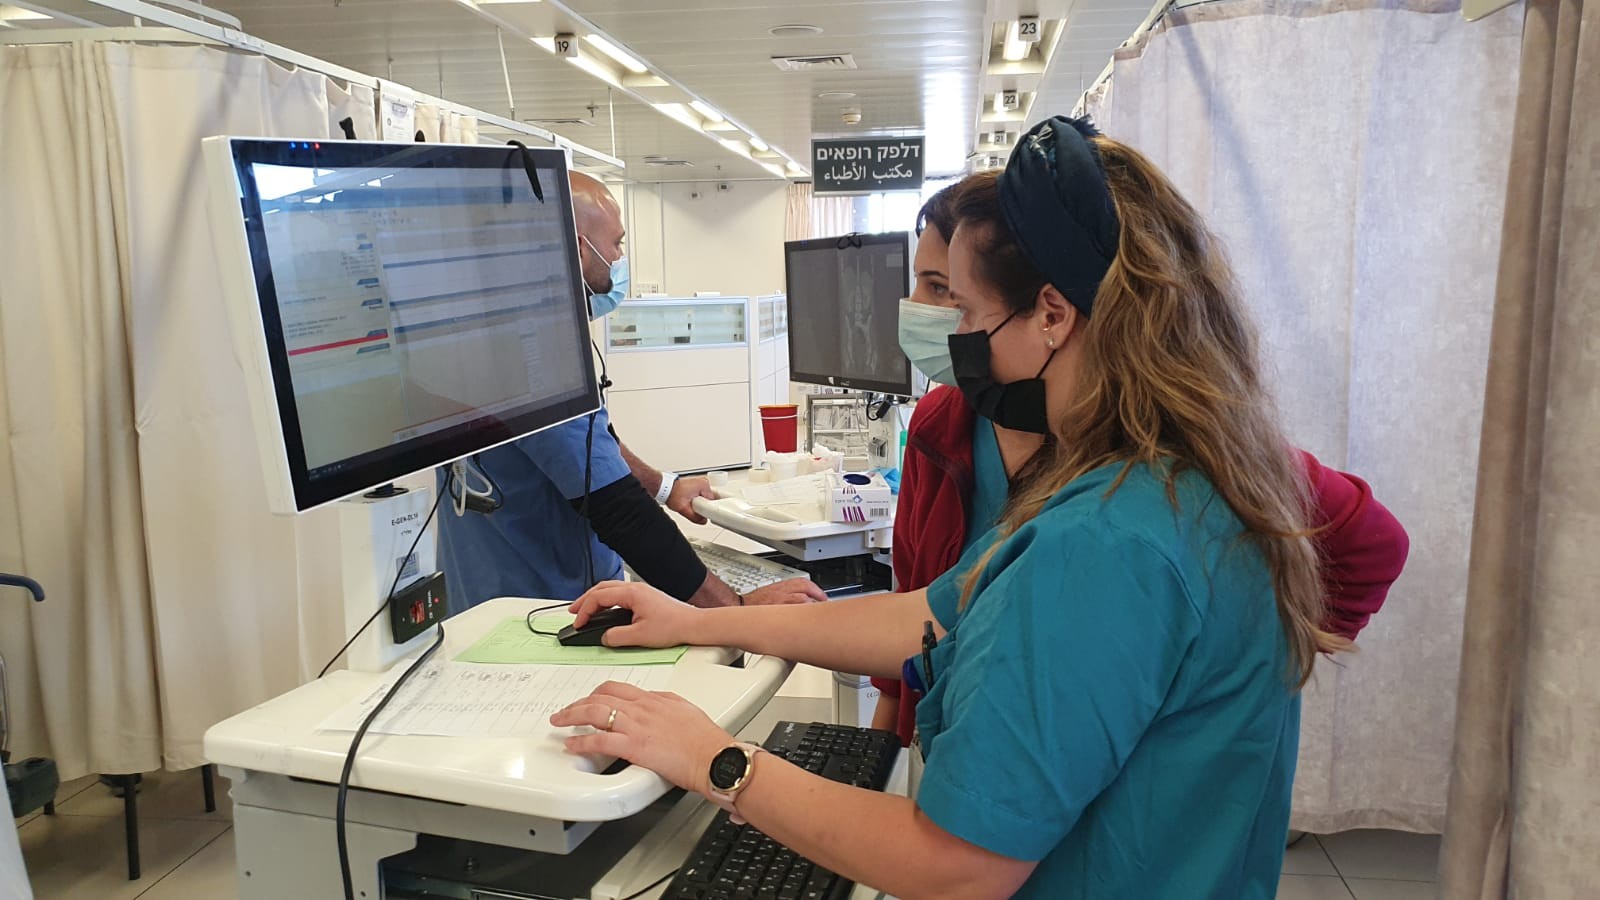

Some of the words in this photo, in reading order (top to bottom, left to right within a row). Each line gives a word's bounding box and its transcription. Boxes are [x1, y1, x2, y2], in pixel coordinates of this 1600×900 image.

[1020, 22, 1037, 35] 23
[557, 40, 569, 52] 19
[1004, 94, 1016, 105] 22
[995, 135, 1004, 143] 21
[816, 147, 872, 161] רופאים
[877, 142, 920, 163] דלפק
[824, 162, 867, 185] الأطباء
[872, 163, 913, 184] مكتب
